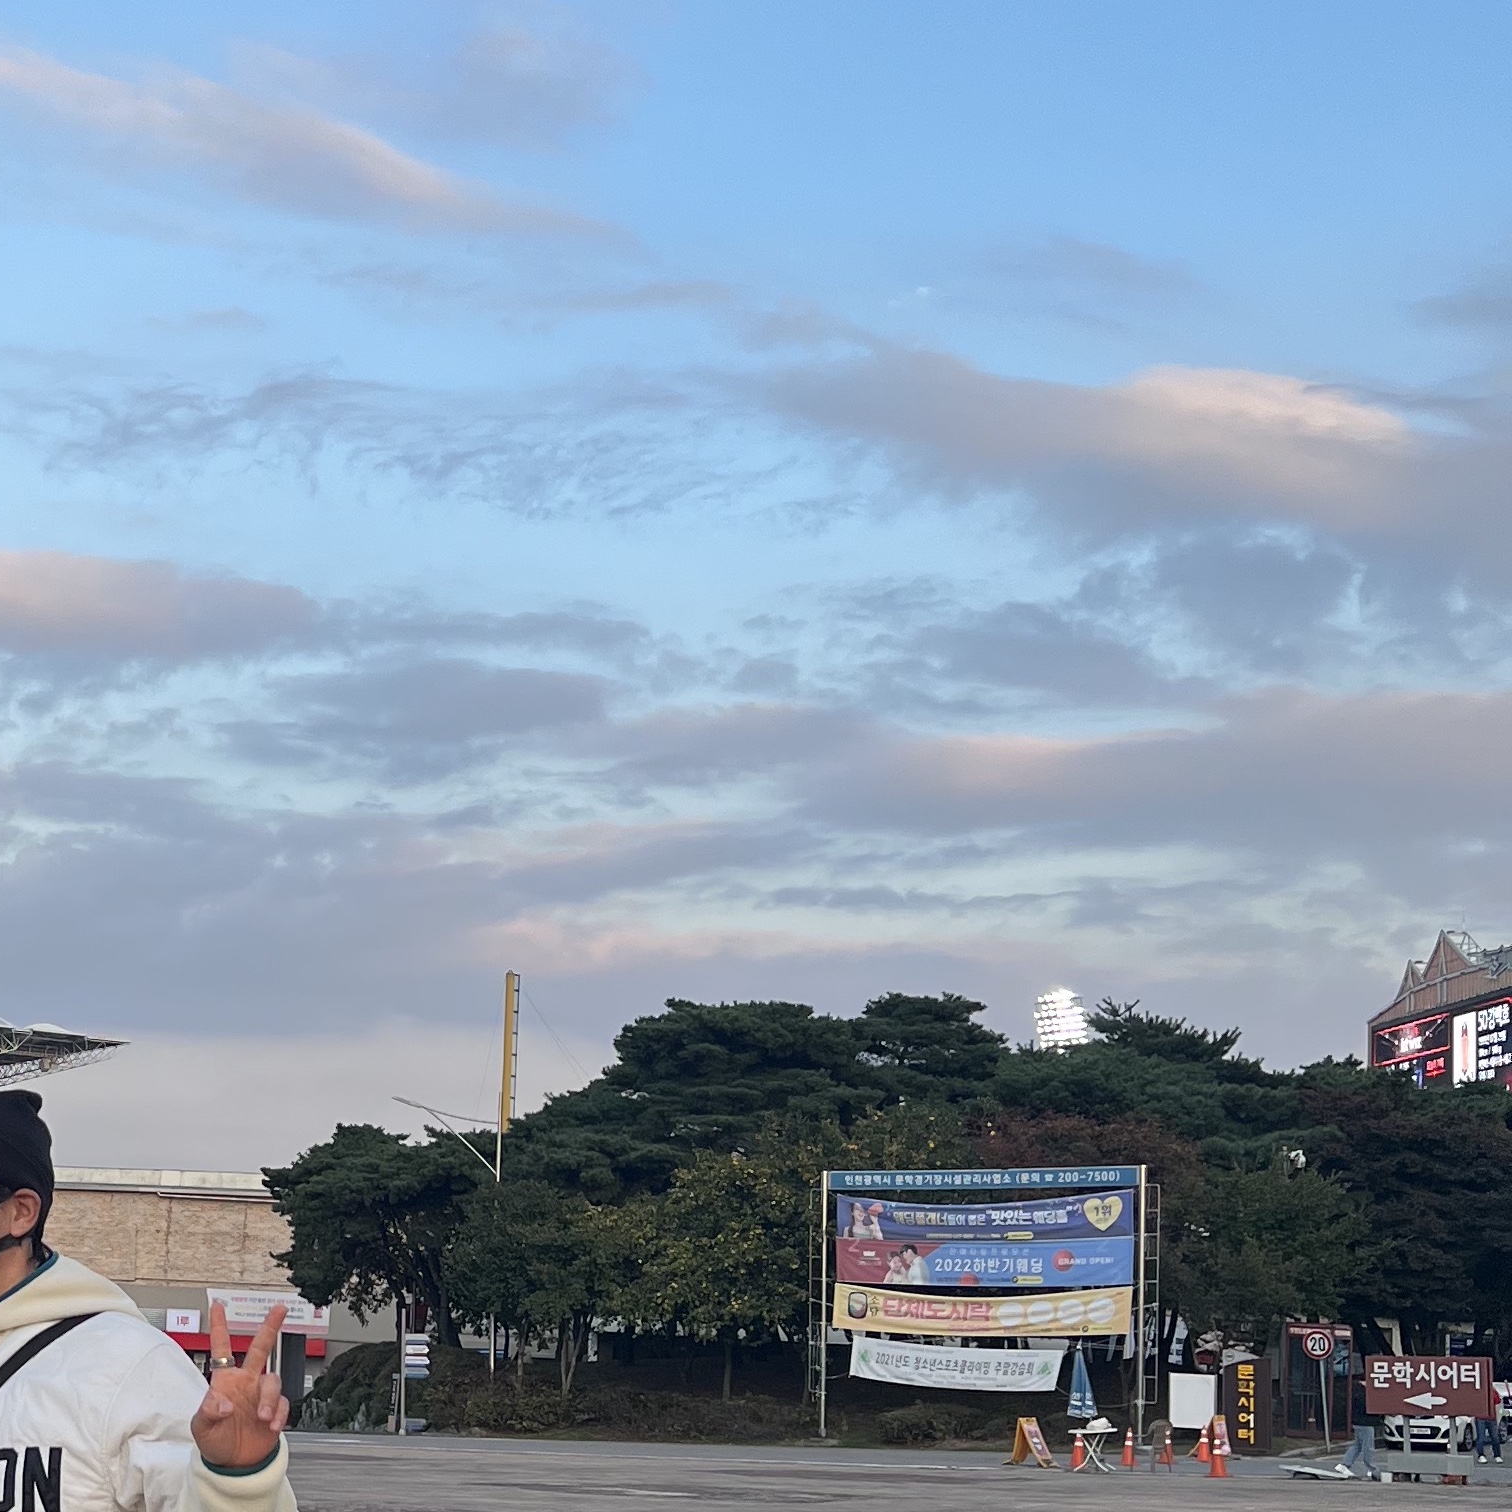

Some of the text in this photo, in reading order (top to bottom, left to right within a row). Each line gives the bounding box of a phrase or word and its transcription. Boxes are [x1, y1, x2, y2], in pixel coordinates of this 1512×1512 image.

[844, 1174, 891, 1186] 인천광역시
[1057, 1170, 1121, 1183] 200-7500)
[1309, 1336, 1327, 1352] 20
[875, 1351, 910, 1368] 2021년도
[1369, 1361, 1481, 1390] 문학시어터
[1237, 1364, 1256, 1445] 문학시어터
